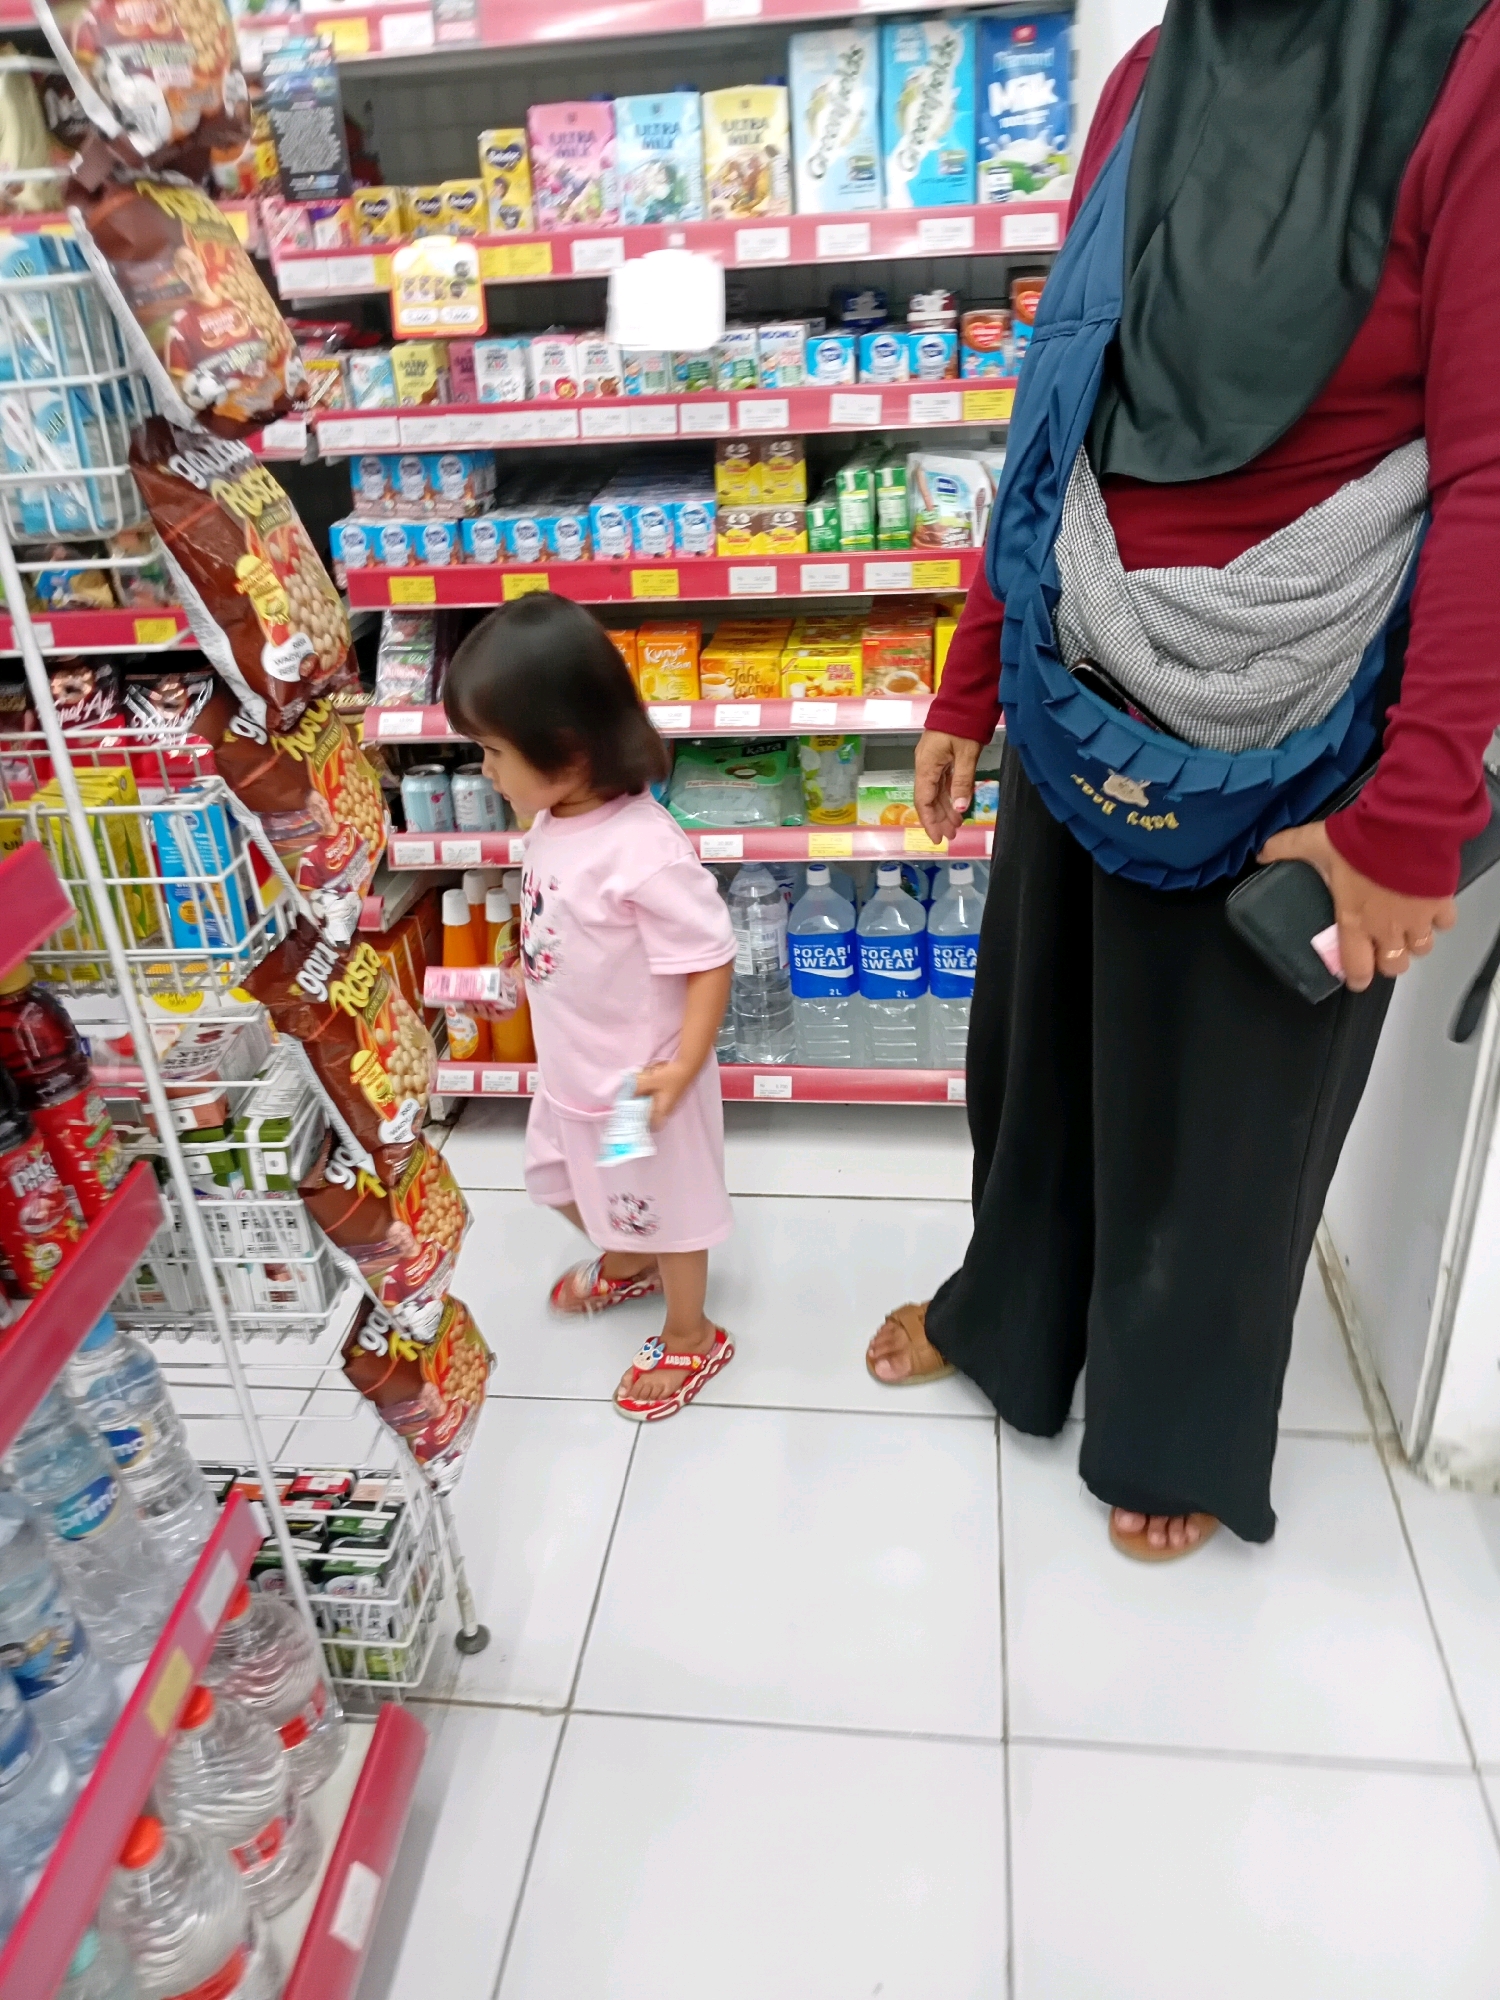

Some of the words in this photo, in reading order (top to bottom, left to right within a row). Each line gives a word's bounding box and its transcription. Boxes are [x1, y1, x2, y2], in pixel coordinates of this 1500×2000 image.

[644, 645, 688, 664] Kunyit
[725, 666, 761, 687] Jahe
[746, 742, 783, 756] kara
[793, 945, 851, 958] POCARI
[860, 946, 919, 960] POCARI
[933, 947, 978, 959] POCA
[794, 957, 848, 968] SWEAT
[861, 957, 915, 970] SWEAT
[934, 956, 978, 969] SWEA
[328, 941, 382, 1017] Rosta
